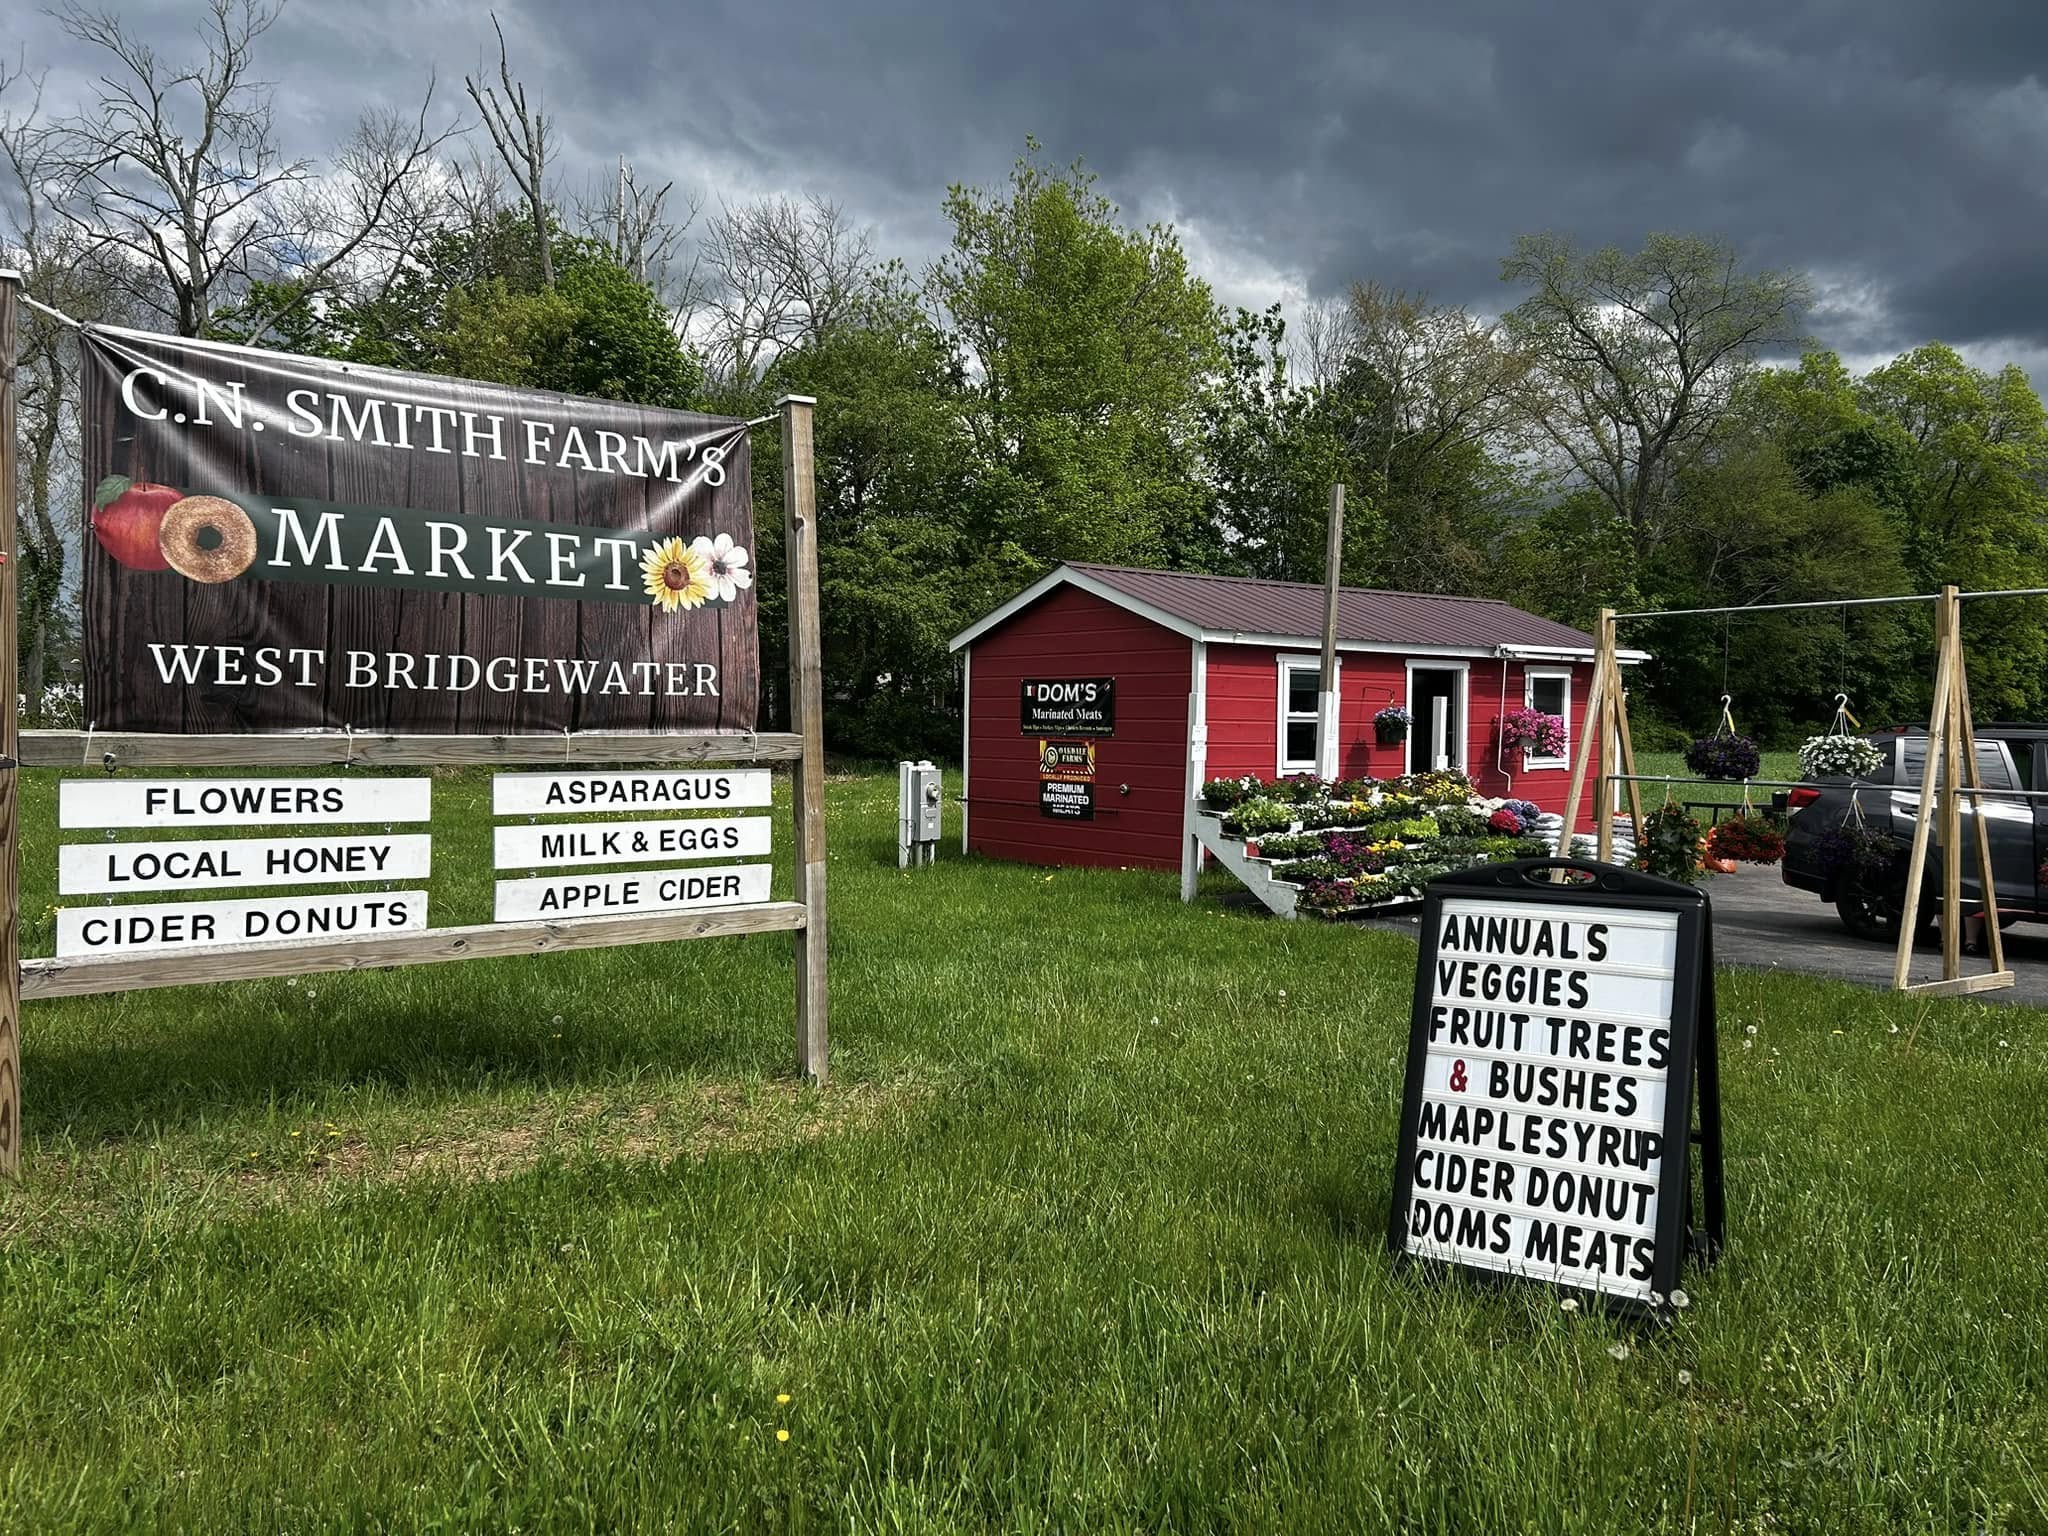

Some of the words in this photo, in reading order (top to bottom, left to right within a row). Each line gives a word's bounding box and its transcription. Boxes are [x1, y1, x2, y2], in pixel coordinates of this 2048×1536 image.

[121, 366, 264, 432] C.N.
[286, 390, 504, 461] SMITH
[524, 420, 727, 488] FARM'S
[268, 508, 638, 591] MARKET
[148, 643, 324, 687] WEST
[345, 650, 720, 697] BRIDGEWATER
[1032, 708, 1074, 720] Marinated
[1076, 708, 1103, 720] Meats
[1037, 683, 1097, 702] DOM'S
[146, 787, 344, 815] FLOWERS
[546, 778, 731, 804] ASPARAGUS
[1042, 793, 1090, 805] MARINATED
[1047, 783, 1085, 794] PREMIUM
[108, 850, 241, 881] LOCAL
[266, 846, 391, 875] HONEY
[541, 831, 621, 858] MILK
[631, 831, 649, 852] &
[659, 827, 739, 852] EGGS
[540, 881, 640, 911] APPLE
[659, 875, 741, 901] CIDER
[82, 914, 216, 946] CIDER
[245, 902, 408, 937] DONUTS
[1441, 914, 1609, 962] ANNUALS
[1438, 961, 1589, 1009] VEGGIES
[1429, 1006, 1530, 1051] FRUIT
[1546, 1016, 1670, 1069] TREES
[1449, 1059, 1468, 1092] &
[1489, 1060, 1637, 1116] BUSHES
[1414, 1149, 1515, 1202] CIDER
[1526, 1167, 1655, 1225] DONUT
[1411, 1199, 1511, 1254] DOMS
[1525, 1220, 1656, 1281] MEATS
